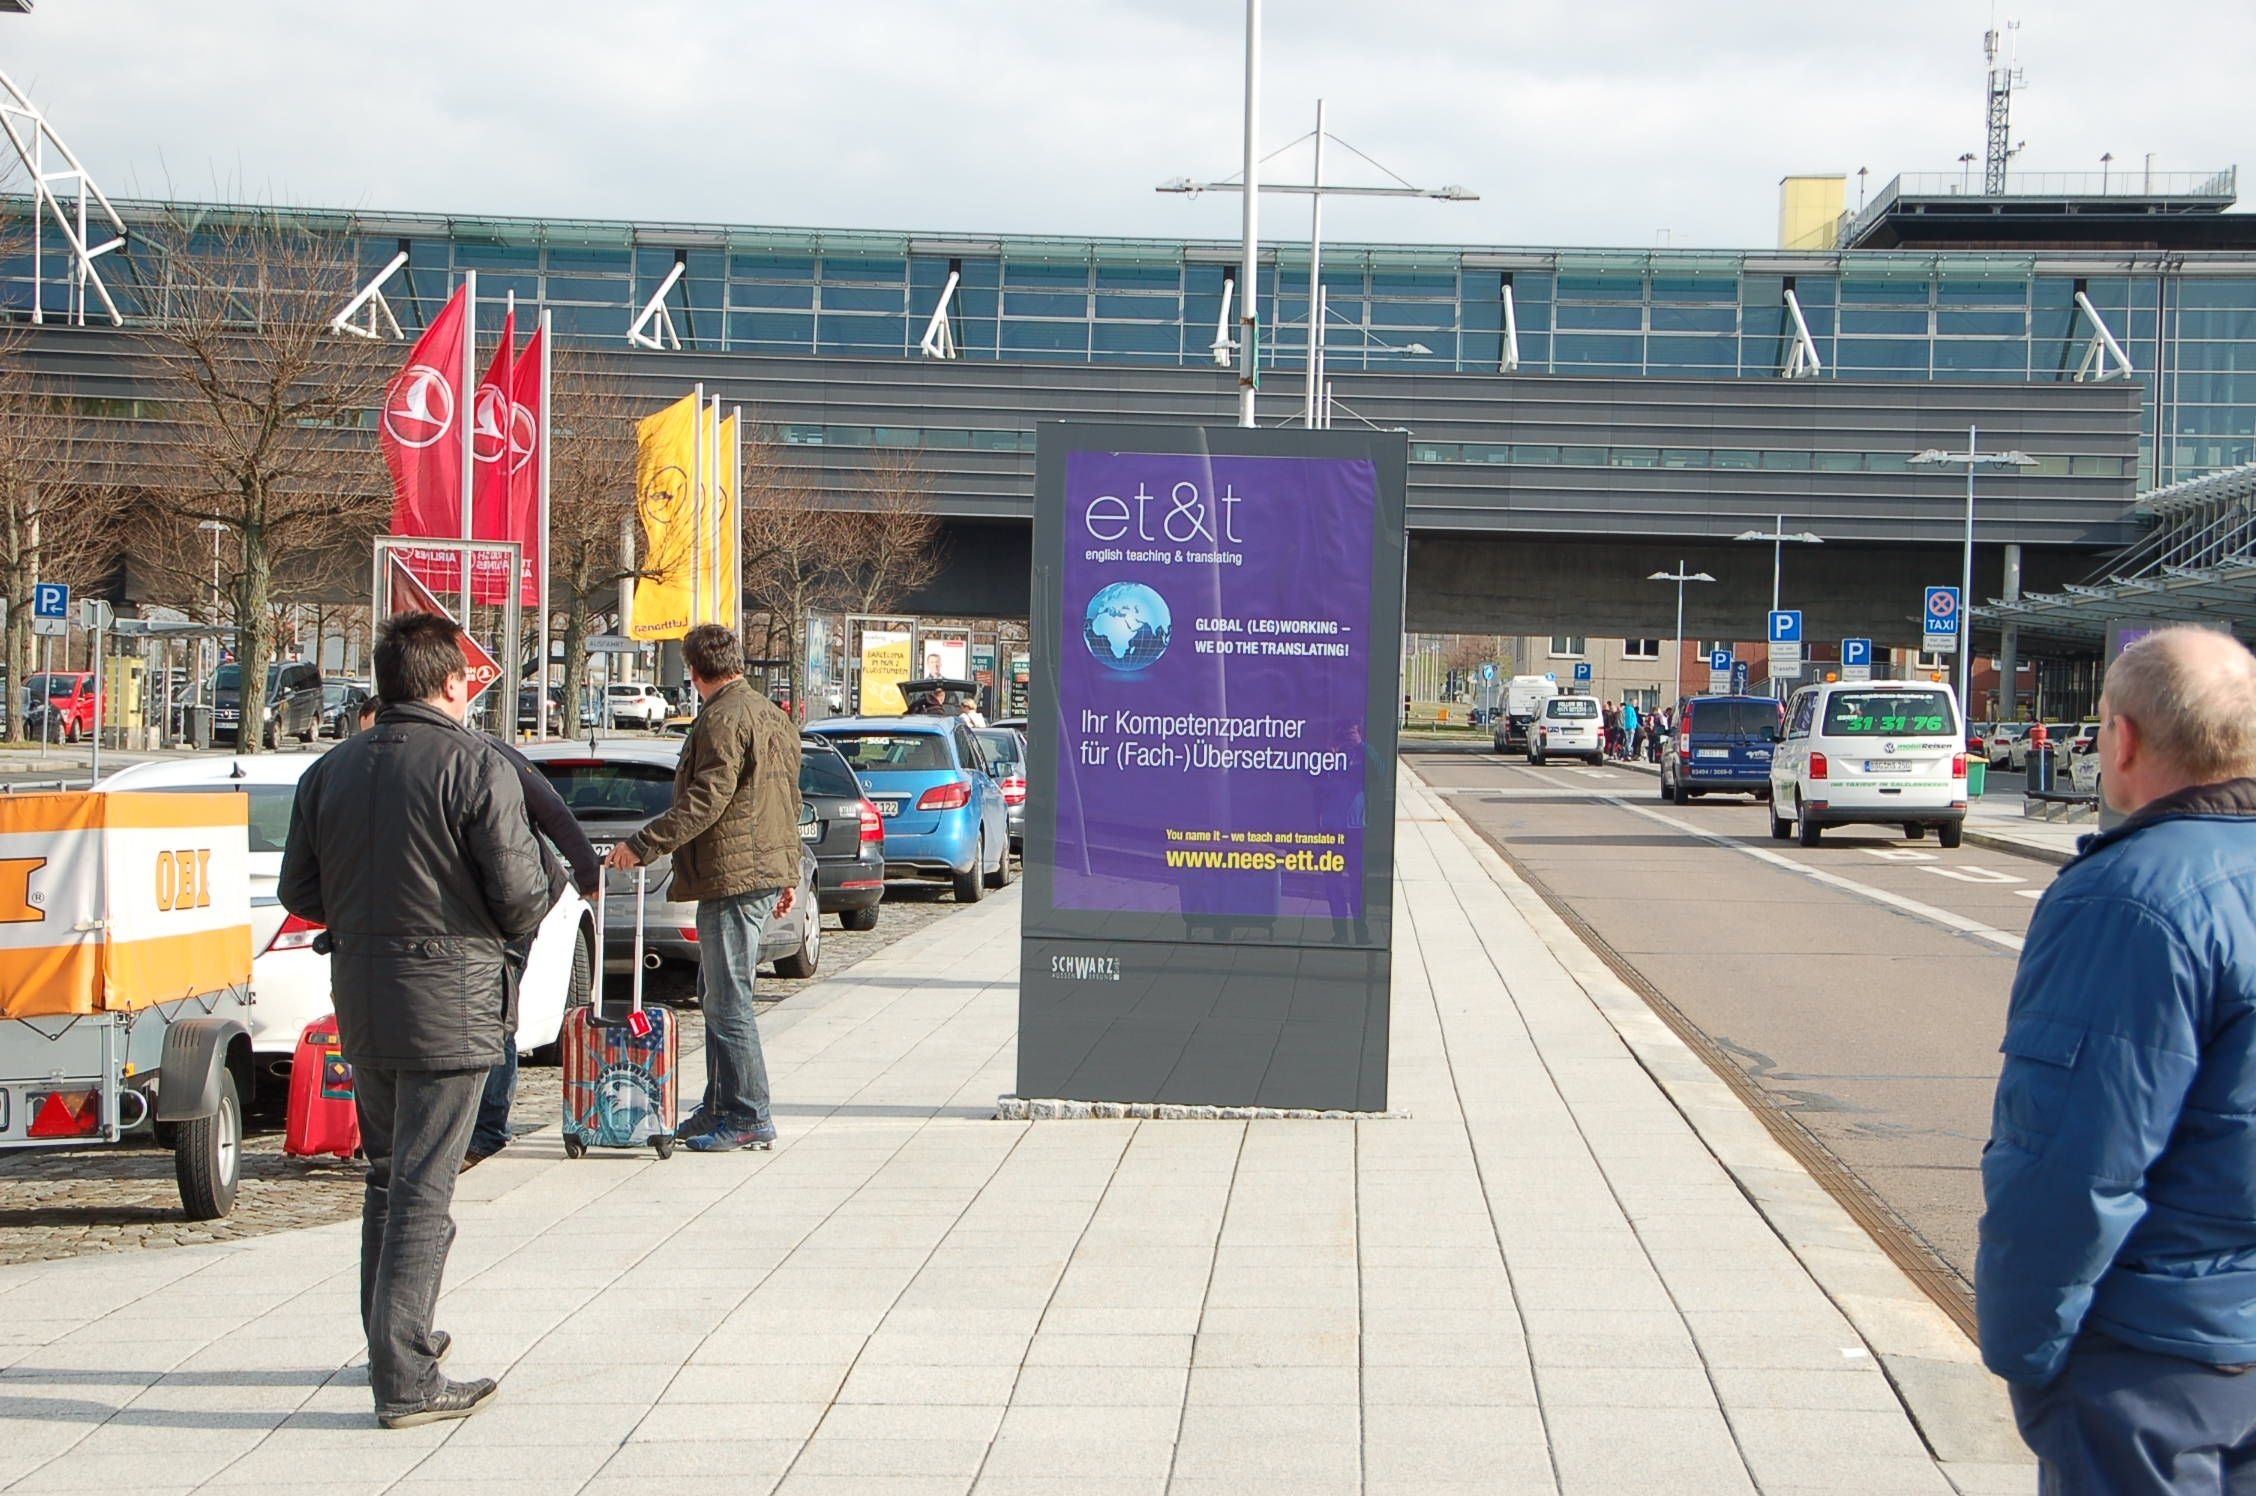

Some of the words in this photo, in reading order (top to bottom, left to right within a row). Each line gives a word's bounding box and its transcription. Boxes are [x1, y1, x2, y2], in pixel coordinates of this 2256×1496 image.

[1085, 481, 1243, 543] et&t
[1085, 548, 1123, 563] english
[1126, 549, 1172, 564] teaching
[1174, 550, 1184, 563] &
[1186, 551, 1243, 566] translating
[41, 588, 61, 613] P
[1195, 618, 1243, 633] GLOBAL
[1247, 619, 1338, 636] (LEG)WORKING
[1775, 614, 1794, 639] P
[1927, 619, 1954, 631] TAXI
[1194, 640, 1215, 654] WE
[1216, 641, 1234, 654] DO
[1235, 641, 1259, 655] THE
[1260, 642, 1349, 657] TRANSLATING!
[1848, 642, 1864, 663] P
[1715, 653, 1727, 668] P
[1577, 665, 1588, 679] P
[1081, 709, 1108, 734] Ihr
[1115, 709, 1306, 742] Kompetenzpartner
[1847, 715, 1874, 731] 31
[1879, 715, 1906, 731] 31
[1913, 715, 1943, 731] 76
[1079, 741, 1110, 766] für
[1165, 828, 1183, 841] You
[1185, 831, 1211, 842] name
[1213, 830, 1221, 842] it
[1231, 833, 1245, 842] we
[1247, 831, 1273, 843] teach
[1274, 832, 1293, 844] and
[1294, 833, 1335, 845] translate
[1337, 833, 1345, 845] it
[1165, 850, 1345, 872] www.nees-ett.de
[155, 848, 211, 912] OBI
[1051, 955, 1114, 980] SCHWARZ
